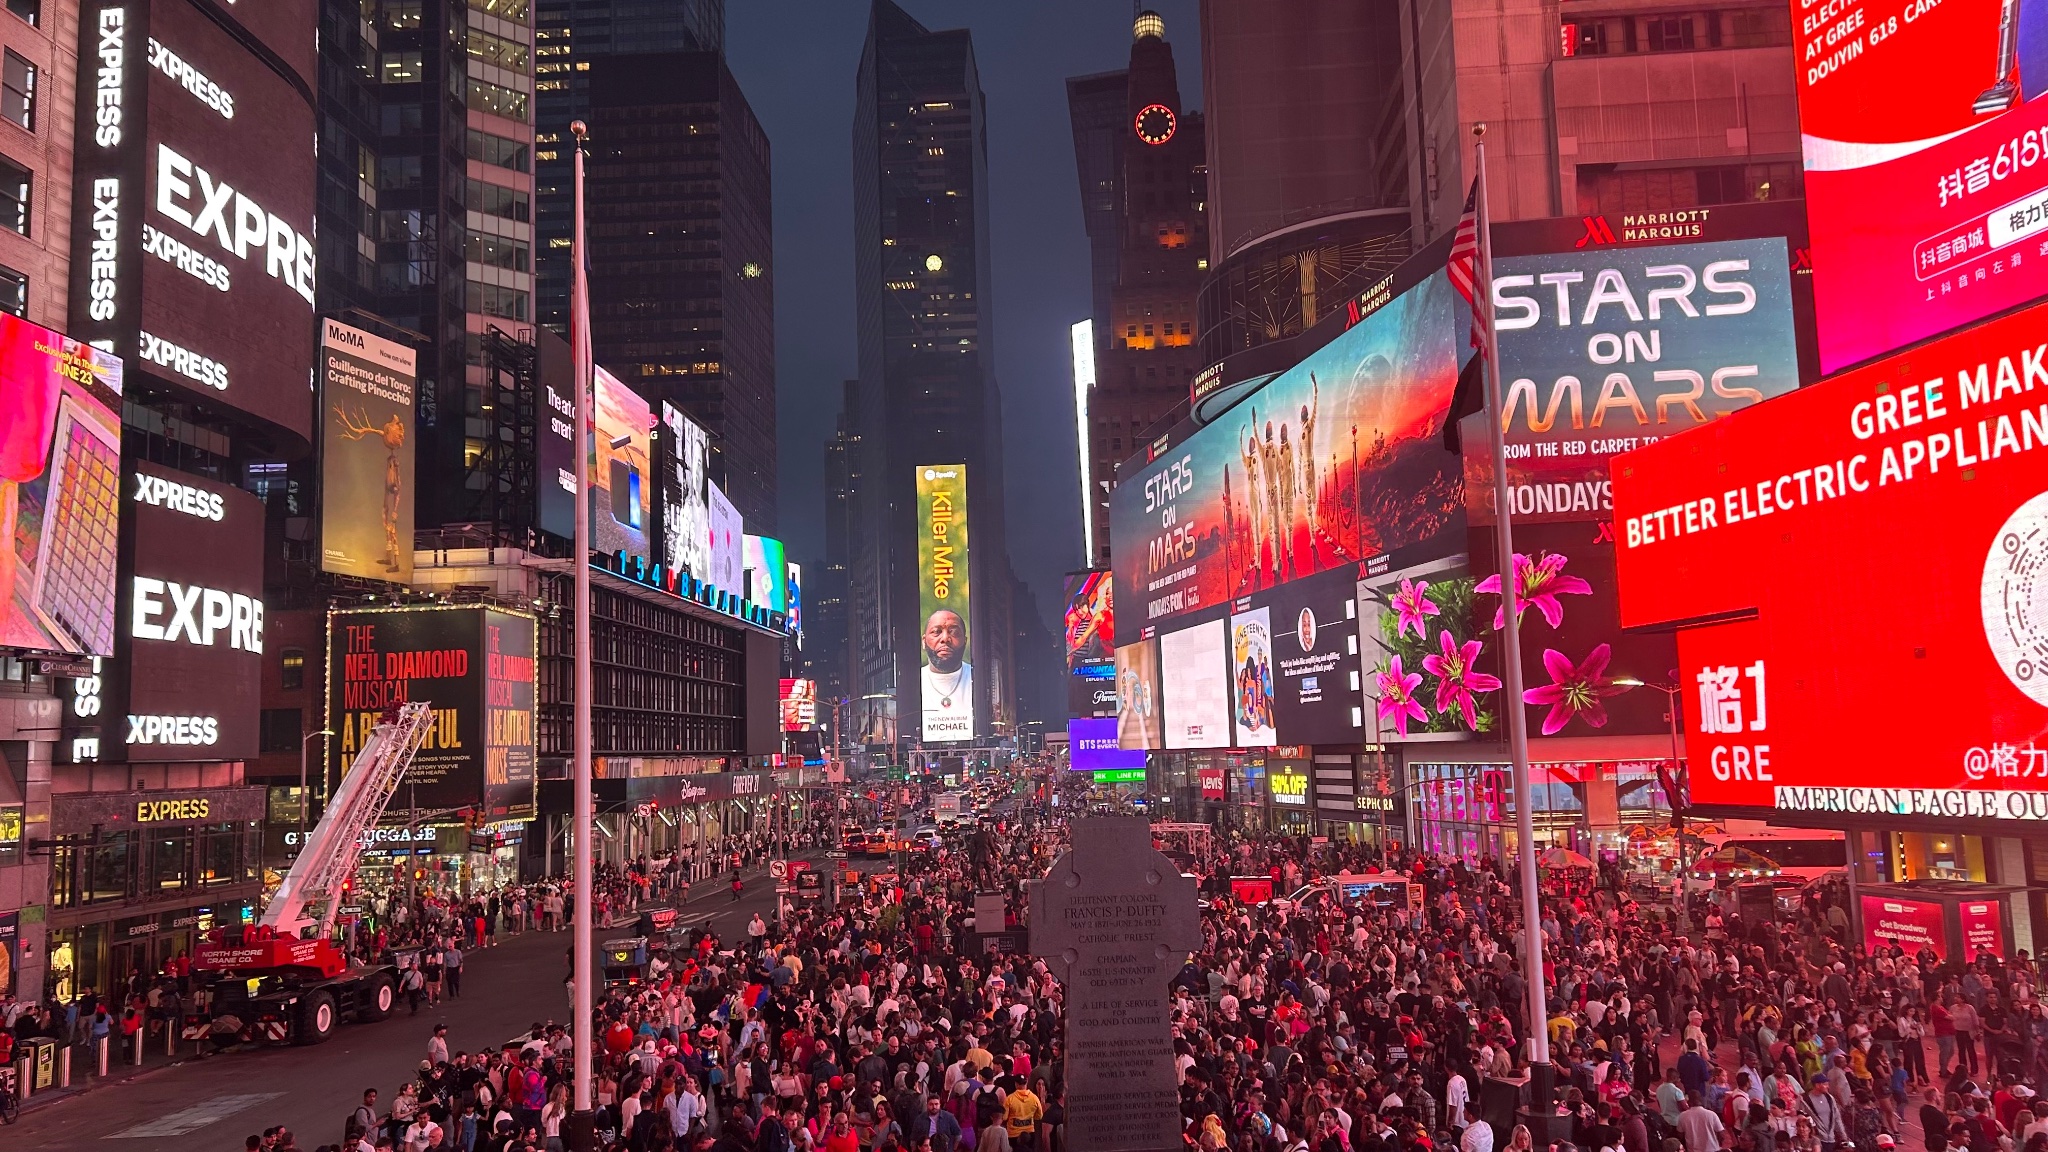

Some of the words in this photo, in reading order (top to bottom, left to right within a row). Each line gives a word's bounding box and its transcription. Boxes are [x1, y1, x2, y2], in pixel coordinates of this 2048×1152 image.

[1805, 35, 1823, 62] AT
[1825, 8, 1865, 47] GREE
[1807, 36, 1864, 87] DOUYIN
[1869, 16, 1898, 46] 618
[96, 7, 124, 148] EXPRESS
[1623, 209, 1710, 227] MARRIOTT
[1624, 224, 1701, 240] MARQUIS
[89, 178, 119, 322] EXPRESS
[1920, 227, 1984, 270] 抖音商城
[1361, 273, 1394, 303] MARRIOTT
[1493, 259, 1757, 331] STARS
[1362, 289, 1391, 316] MARQUIS
[328, 324, 365, 350] MoMA
[1587, 329, 1661, 365] ON
[33, 339, 73, 365] Exclusively
[379, 348, 392, 359] Now
[53, 361, 80, 381] JUNE
[79, 370, 94, 386] 23
[328, 356, 375, 382] Guillermo
[375, 371, 390, 387] del
[389, 376, 411, 395] Toro:
[328, 369, 368, 394] Crafting
[368, 382, 411, 406] Pinocchio
[1502, 364, 1764, 434] MARS
[546, 385, 561, 411] The
[561, 399, 571, 418] art
[1850, 377, 1948, 440] GREE
[551, 417, 572, 441] smart
[1535, 443, 1559, 458] THE
[1562, 440, 1587, 456] RED
[1590, 437, 1637, 455] CARPET
[1145, 454, 1193, 514] STARS
[1626, 496, 1719, 550] BETTER
[1724, 453, 1870, 525] ELECTRIC
[931, 491, 952, 543] Killer
[1162, 504, 1176, 529] ON
[1149, 521, 1197, 575] MARS
[933, 546, 954, 599] Mike
[680, 573, 772, 628] BROADWAY
[1170, 590, 1184, 614] FOX
[346, 625, 375, 653] THE
[488, 625, 500, 652] THE
[345, 653, 383, 681] NEIL
[386, 649, 468, 680] DIAMOND
[488, 653, 502, 681] NEIL
[503, 654, 534, 683] DIAMOND
[1073, 667, 1080, 675] A
[488, 680, 514, 708] MUSICAL
[342, 713, 355, 752] A
[487, 709, 494, 746] A
[493, 708, 532, 747] BEAUTIFUL
[927, 723, 968, 731] MICHAEL
[1080, 740, 1095, 750] BTS
[486, 747, 509, 786] NOISE
[1711, 745, 1773, 781] GRE
[732, 775, 754, 795] FOREVER
[1271, 774, 1290, 795] 50%
[1290, 775, 1308, 796] OFF
[137, 799, 209, 822] EXPRESS
[1777, 787, 1901, 815] AMERICAN
[1909, 790, 1998, 818] EAGLE
[1064, 907, 1112, 919] FRANCIS
[1070, 921, 1086, 929] MAY
[129, 923, 160, 936] EXPRESS
[1078, 935, 1119, 944] CATHOLIC
[1124, 933, 1155, 942] PRIEST
[1880, 920, 1893, 929] Get
[1893, 921, 1927, 934] Broadway
[1097, 955, 1137, 964] CHAPLAIN
[1090, 979, 1107, 987] OLD
[1091, 1001, 1108, 1009] LIFE
[1111, 1000, 1121, 1008] OF
[1125, 999, 1158, 1008] SERVICE
[1079, 1019, 1099, 1027] GOD
[1100, 1018, 1119, 1026] AND
[1122, 1016, 1161, 1025] COUNTRY
[1147, 1048, 1173, 1056] GUARD
[1097, 1071, 1125, 1079] WORLD
[1129, 1070, 1147, 1078] WAR
